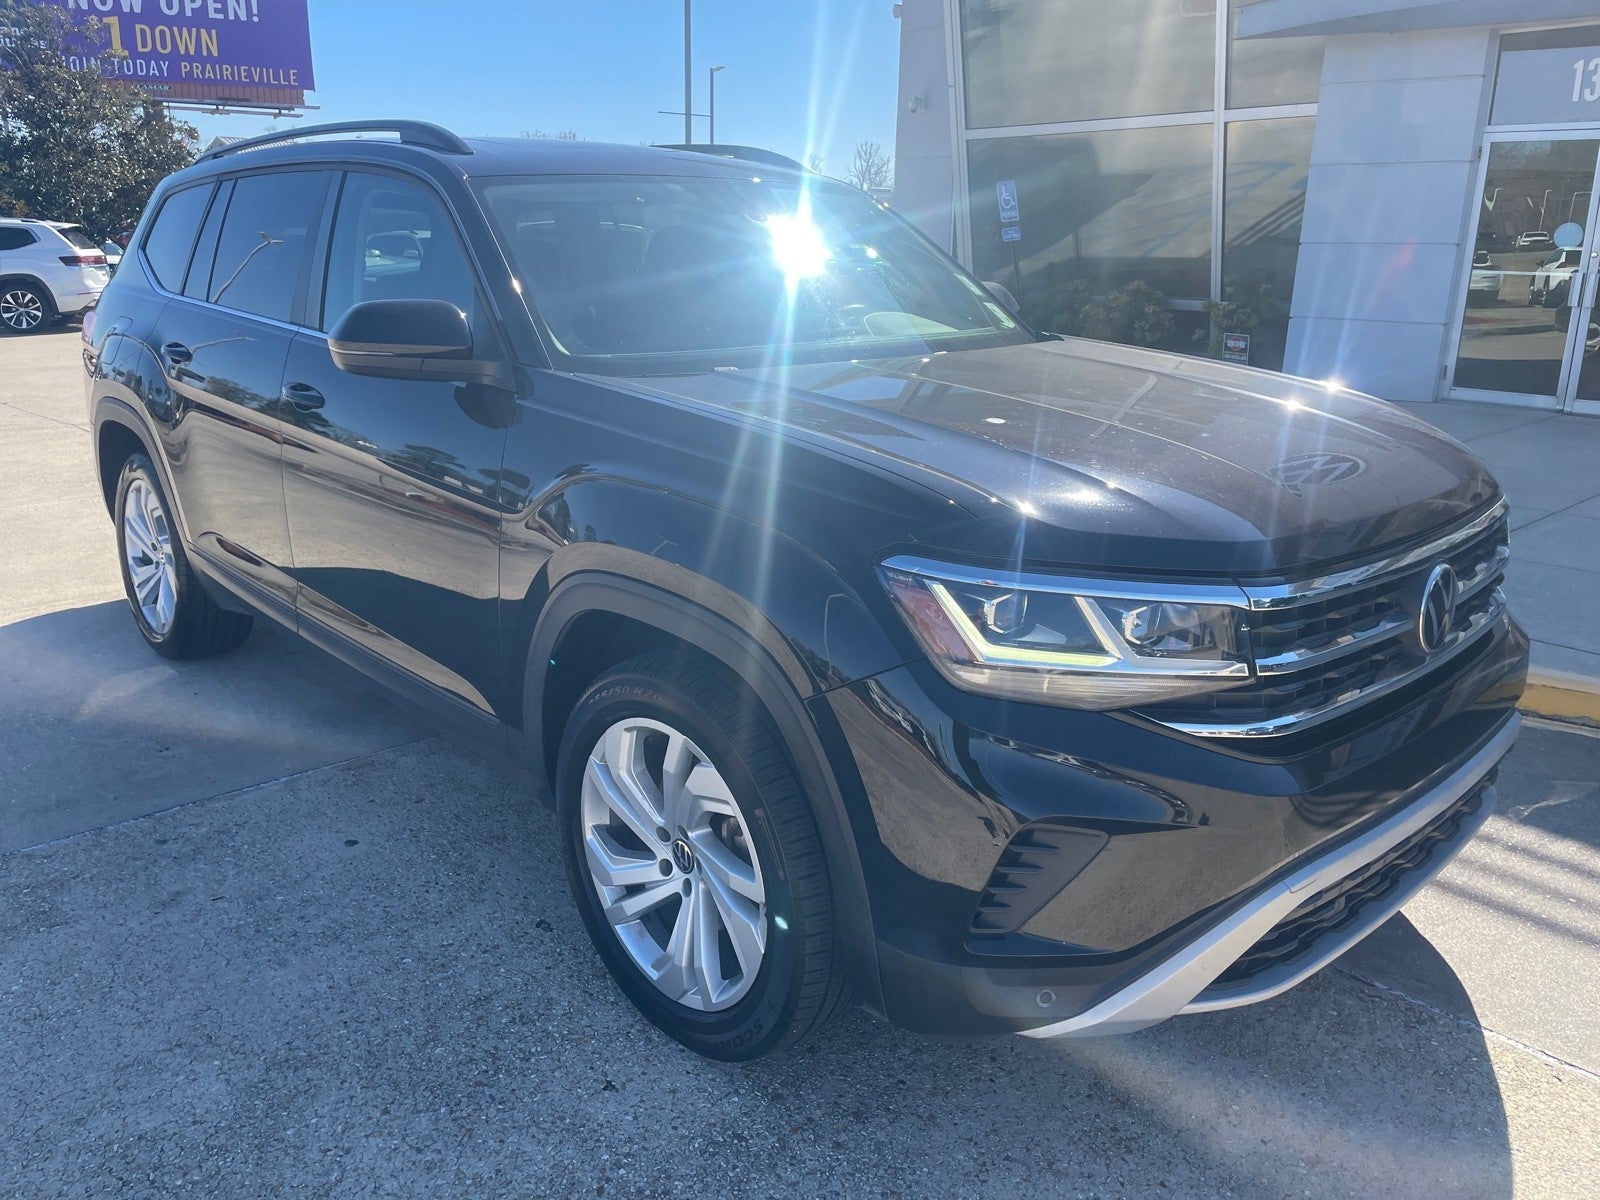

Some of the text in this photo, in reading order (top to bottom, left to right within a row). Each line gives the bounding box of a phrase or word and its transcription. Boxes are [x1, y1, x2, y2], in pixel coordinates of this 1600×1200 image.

[160, 0, 259, 22] OPEN!
[135, 24, 219, 57] DOWN
[111, 58, 168, 77] TODAY
[181, 61, 299, 86] PRAIRIEVILLE
